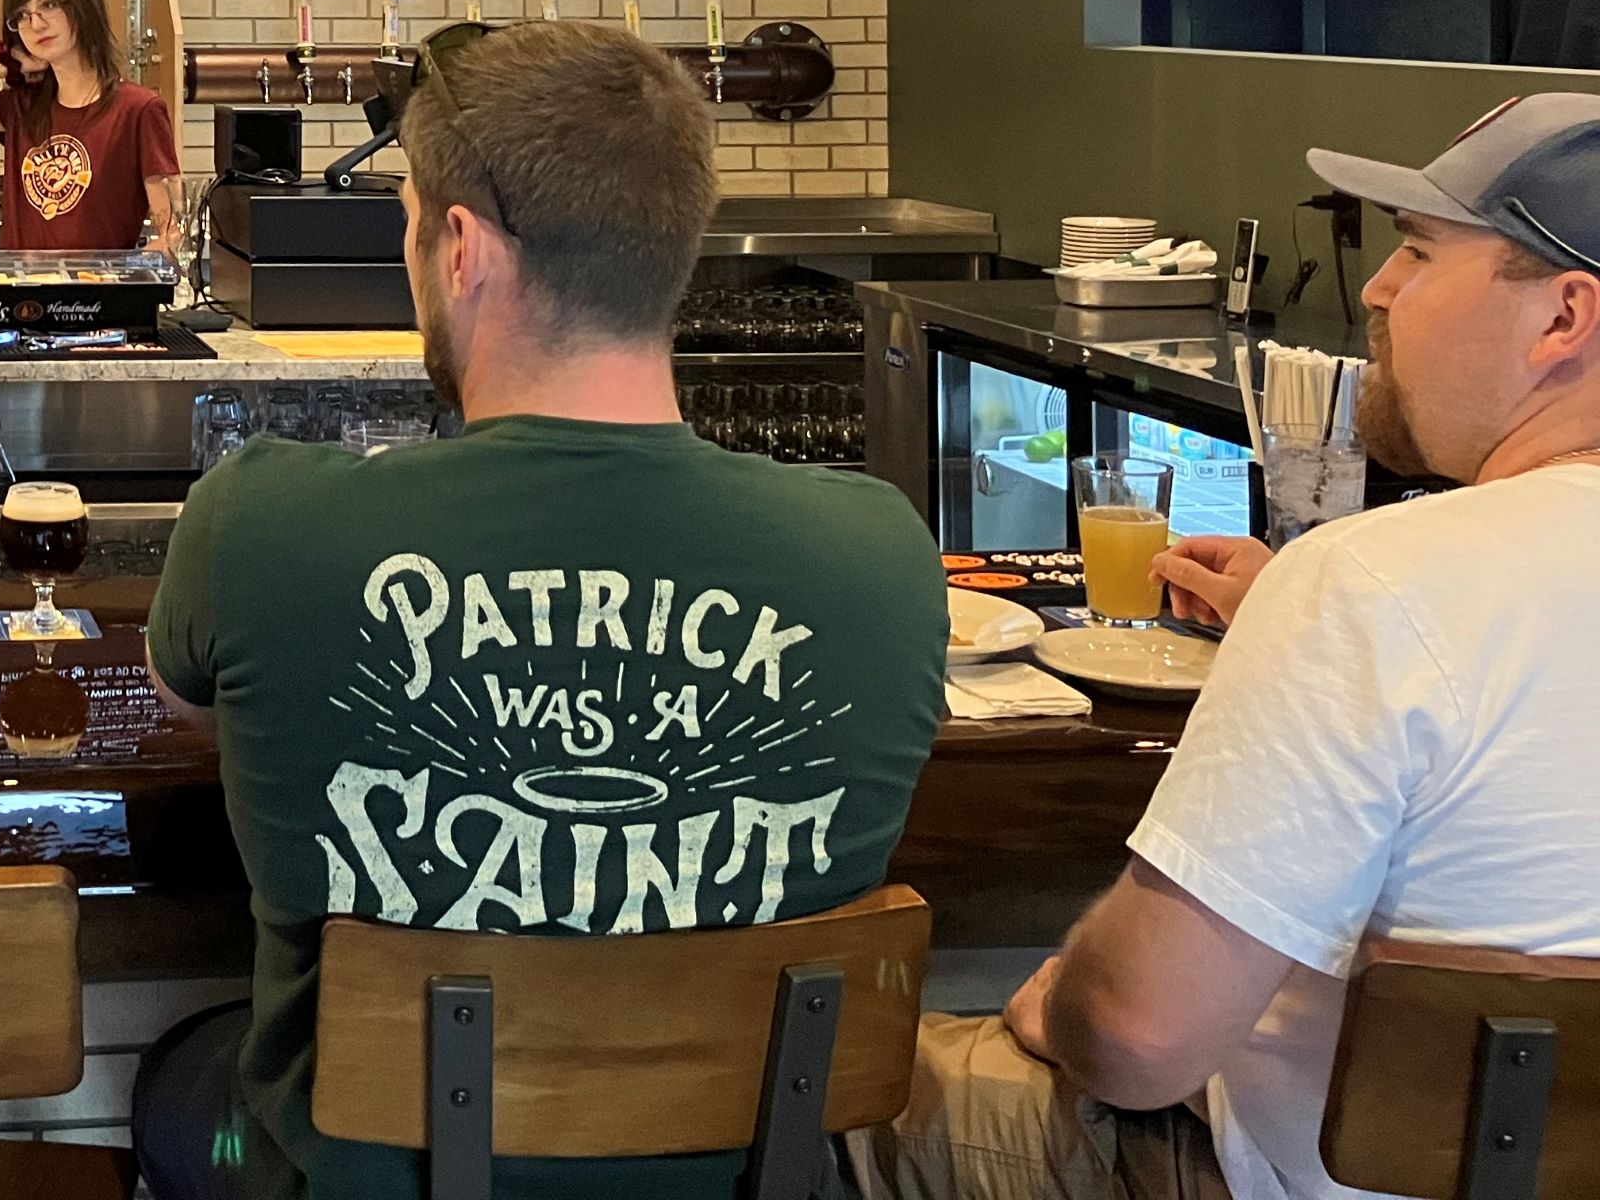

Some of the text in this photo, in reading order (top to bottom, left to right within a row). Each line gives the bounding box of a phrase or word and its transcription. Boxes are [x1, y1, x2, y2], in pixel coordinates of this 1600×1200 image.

[47, 300, 101, 314] Handmade
[54, 313, 94, 322] VODKA
[363, 552, 813, 702] PATRICK
[483, 674, 701, 756] WAS A
